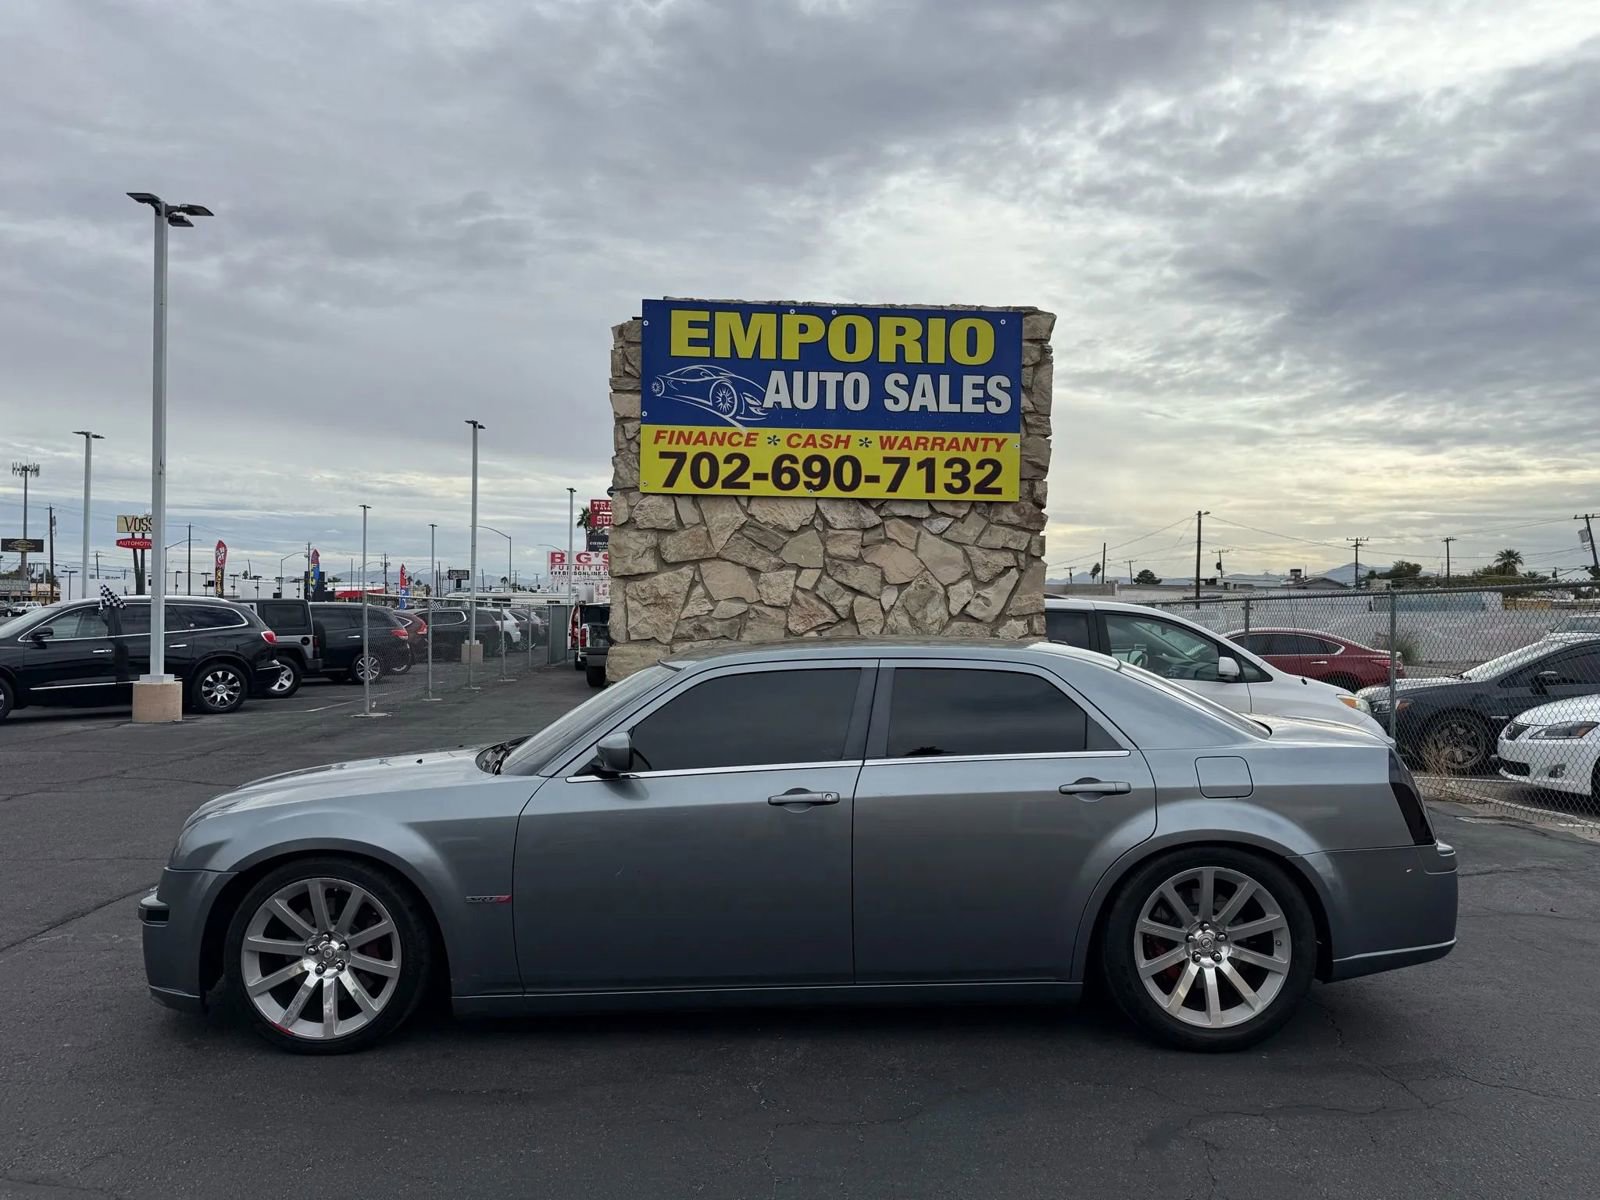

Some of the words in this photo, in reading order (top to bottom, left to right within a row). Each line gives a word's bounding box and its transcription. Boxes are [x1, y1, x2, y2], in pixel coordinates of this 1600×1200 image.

[669, 308, 996, 366] EMPORIO
[762, 370, 870, 412] AUTO
[884, 373, 1012, 415] SALES
[653, 430, 759, 449] FINANCE
[786, 432, 852, 450] CASH
[878, 435, 1009, 453] WARRANTY
[658, 451, 1004, 496] 702-690-7132
